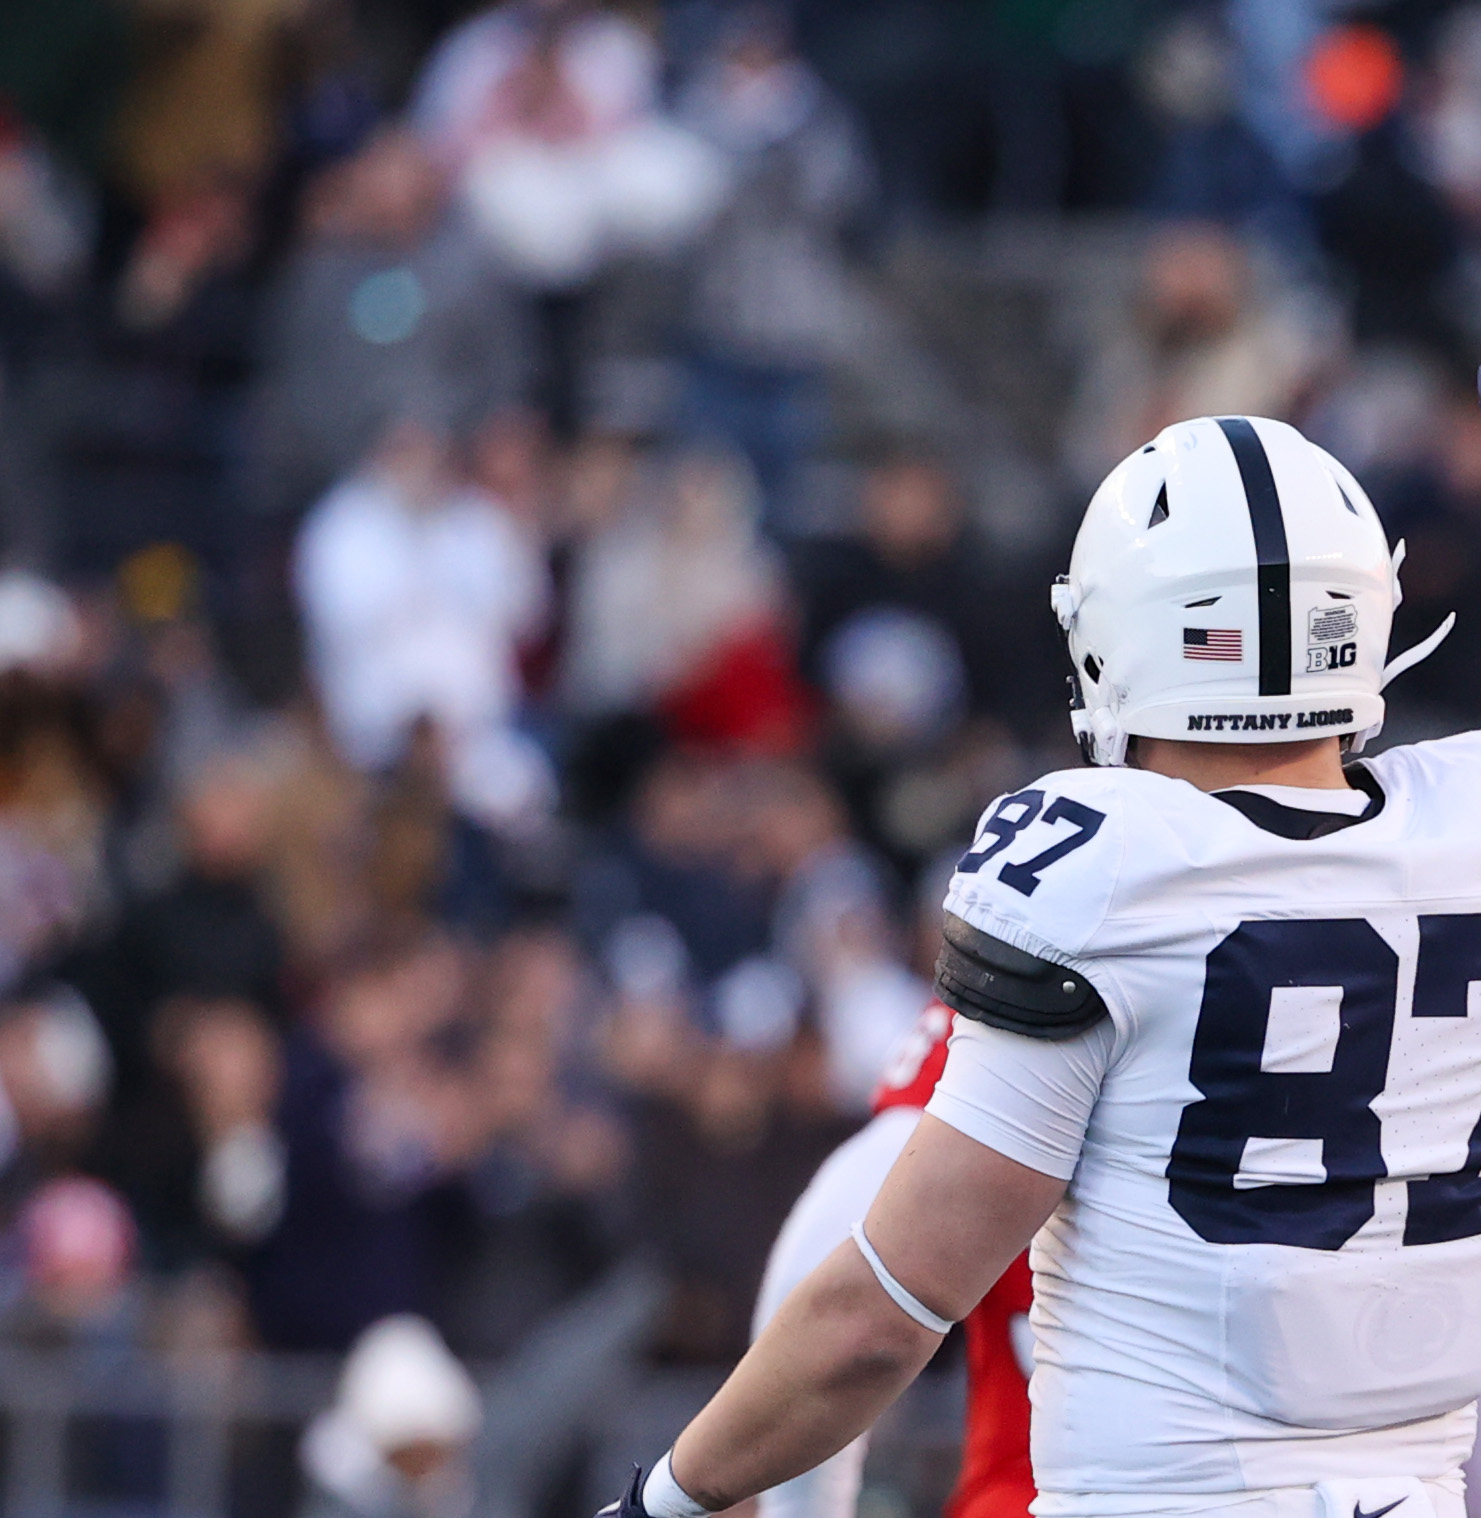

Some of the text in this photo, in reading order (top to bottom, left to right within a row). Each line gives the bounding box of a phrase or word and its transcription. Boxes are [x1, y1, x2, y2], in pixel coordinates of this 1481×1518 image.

[1188, 708, 1354, 731] NITTANY LIONS
[957, 788, 1107, 898] 87
